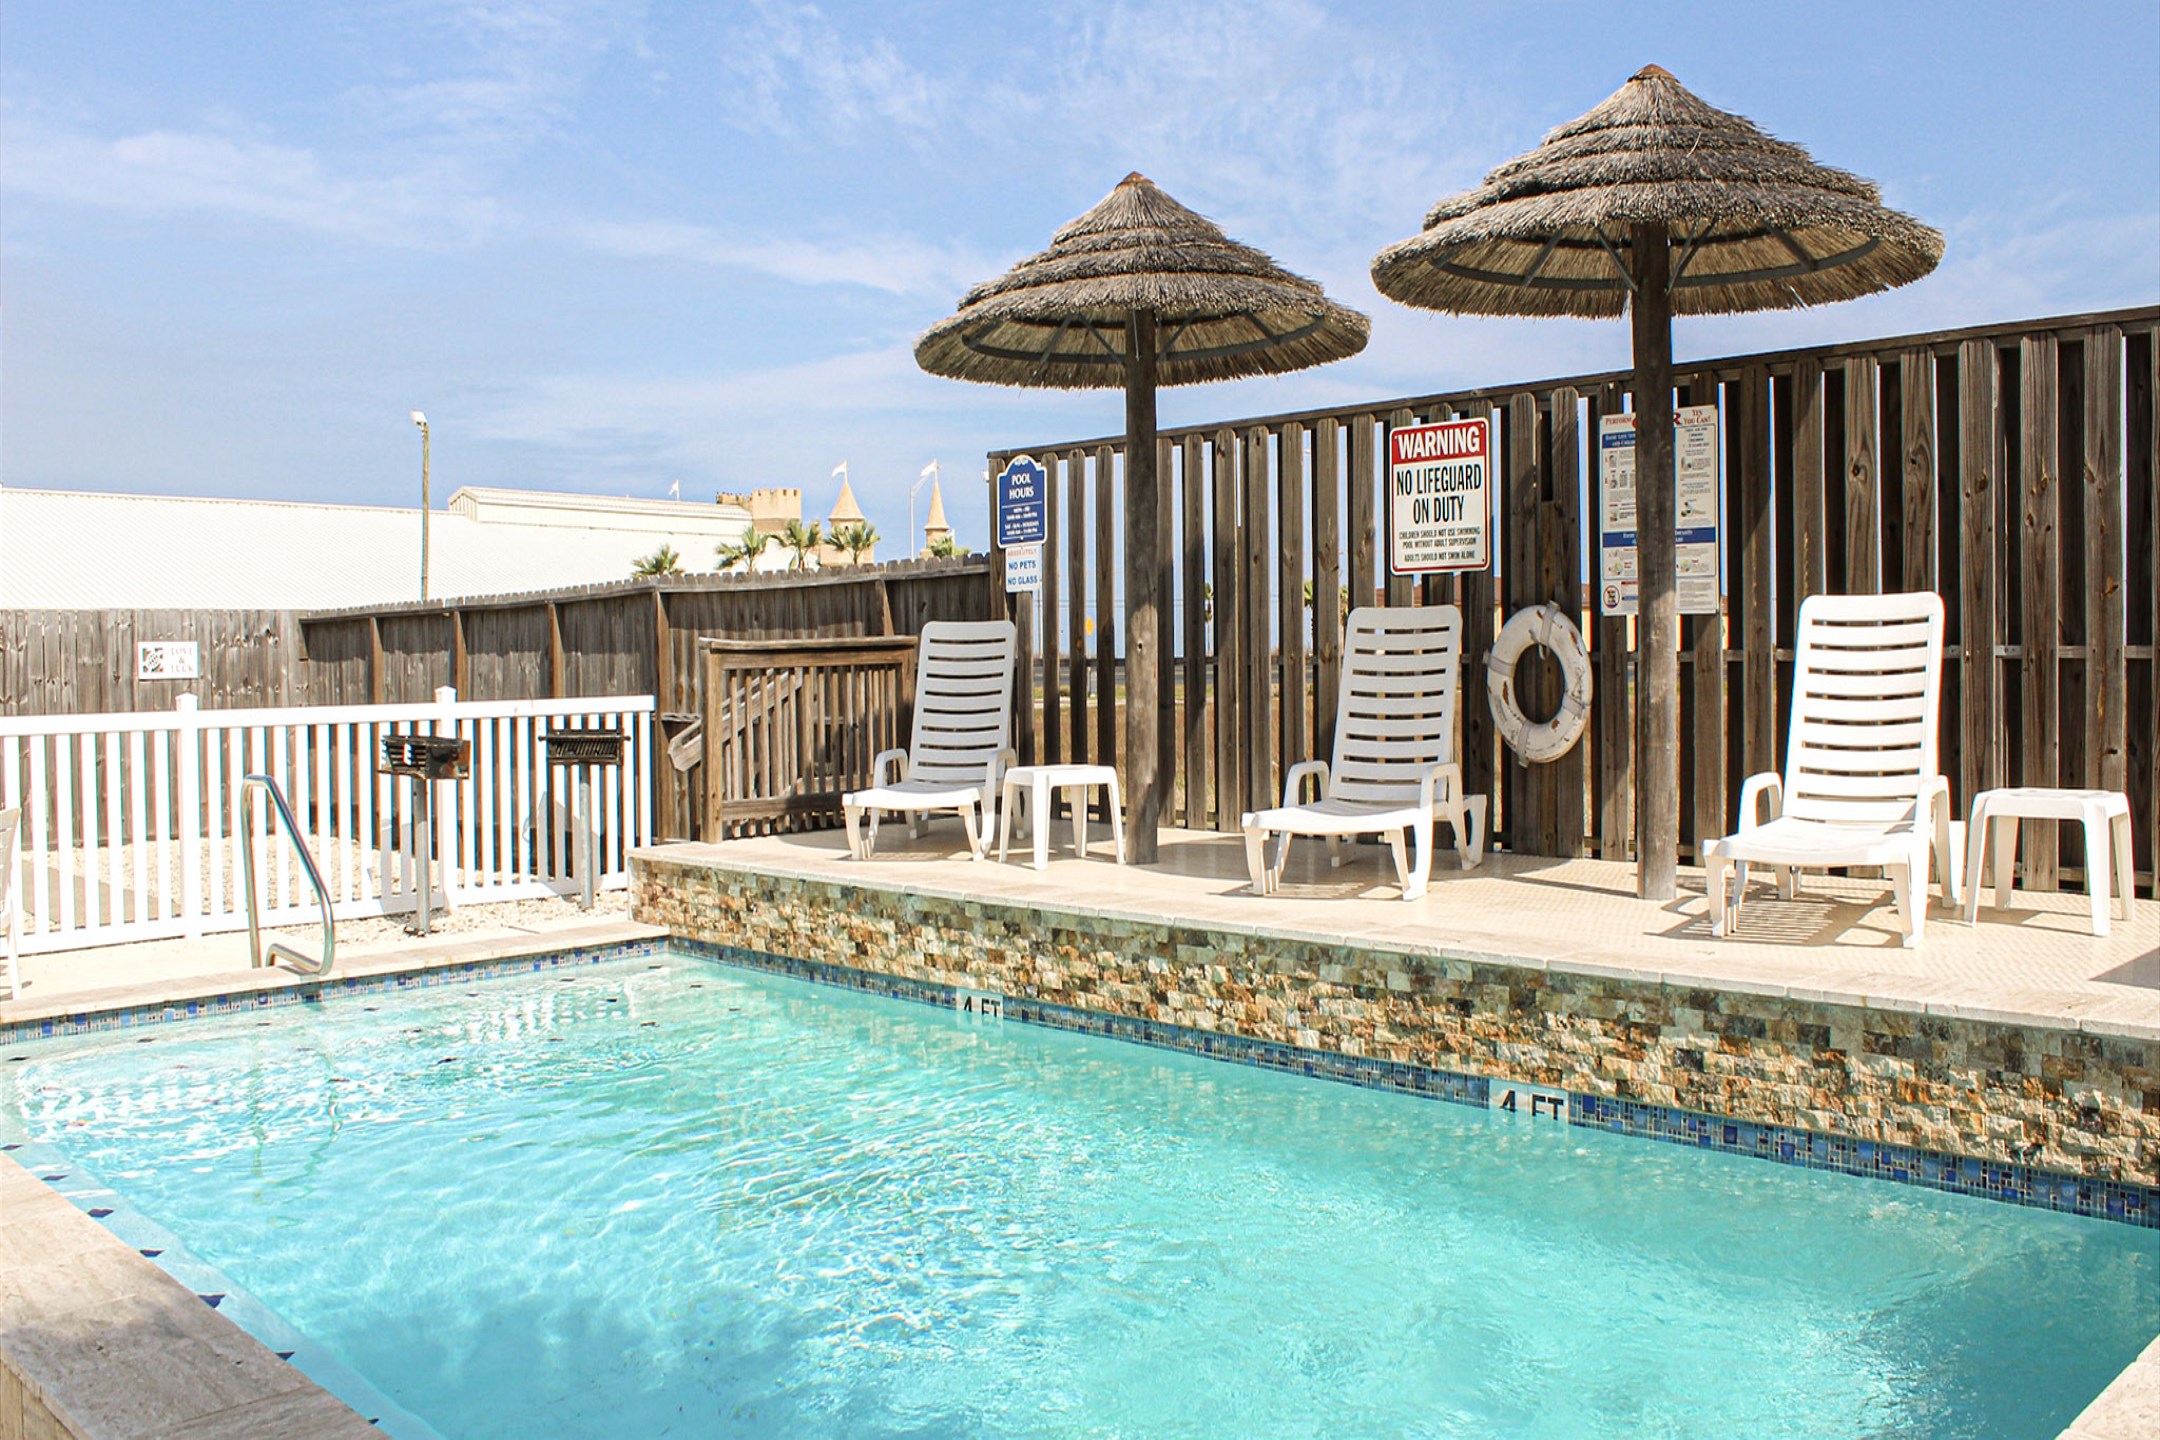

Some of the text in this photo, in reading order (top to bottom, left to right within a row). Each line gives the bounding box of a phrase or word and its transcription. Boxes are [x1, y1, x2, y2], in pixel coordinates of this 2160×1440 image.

[1397, 425, 1480, 460] WARNING
[1011, 472, 1031, 486] POOL
[1396, 464, 1482, 496] NO LIFEGUARD
[1008, 486, 1034, 500] HOURS
[1413, 495, 1464, 525] ON DUTY
[1399, 530, 1419, 540] CHILDREN
[1420, 529, 1437, 539] SHOULD
[1438, 528, 1447, 537] NOT
[1456, 526, 1480, 536] SWIMMING
[1414, 539, 1433, 548] WITHOUT
[1434, 538, 1447, 547] ADULT
[1448, 537, 1477, 547] SUPERVISION
[1404, 550, 1475, 562] ADULTS SHOULD NOT SWIM ALONE
[1008, 559, 1037, 570] NO PETS
[1017, 575, 1038, 585] GLASS
[981, 997, 1001, 1018] FT
[1500, 1089, 1564, 1121] 4 FT
